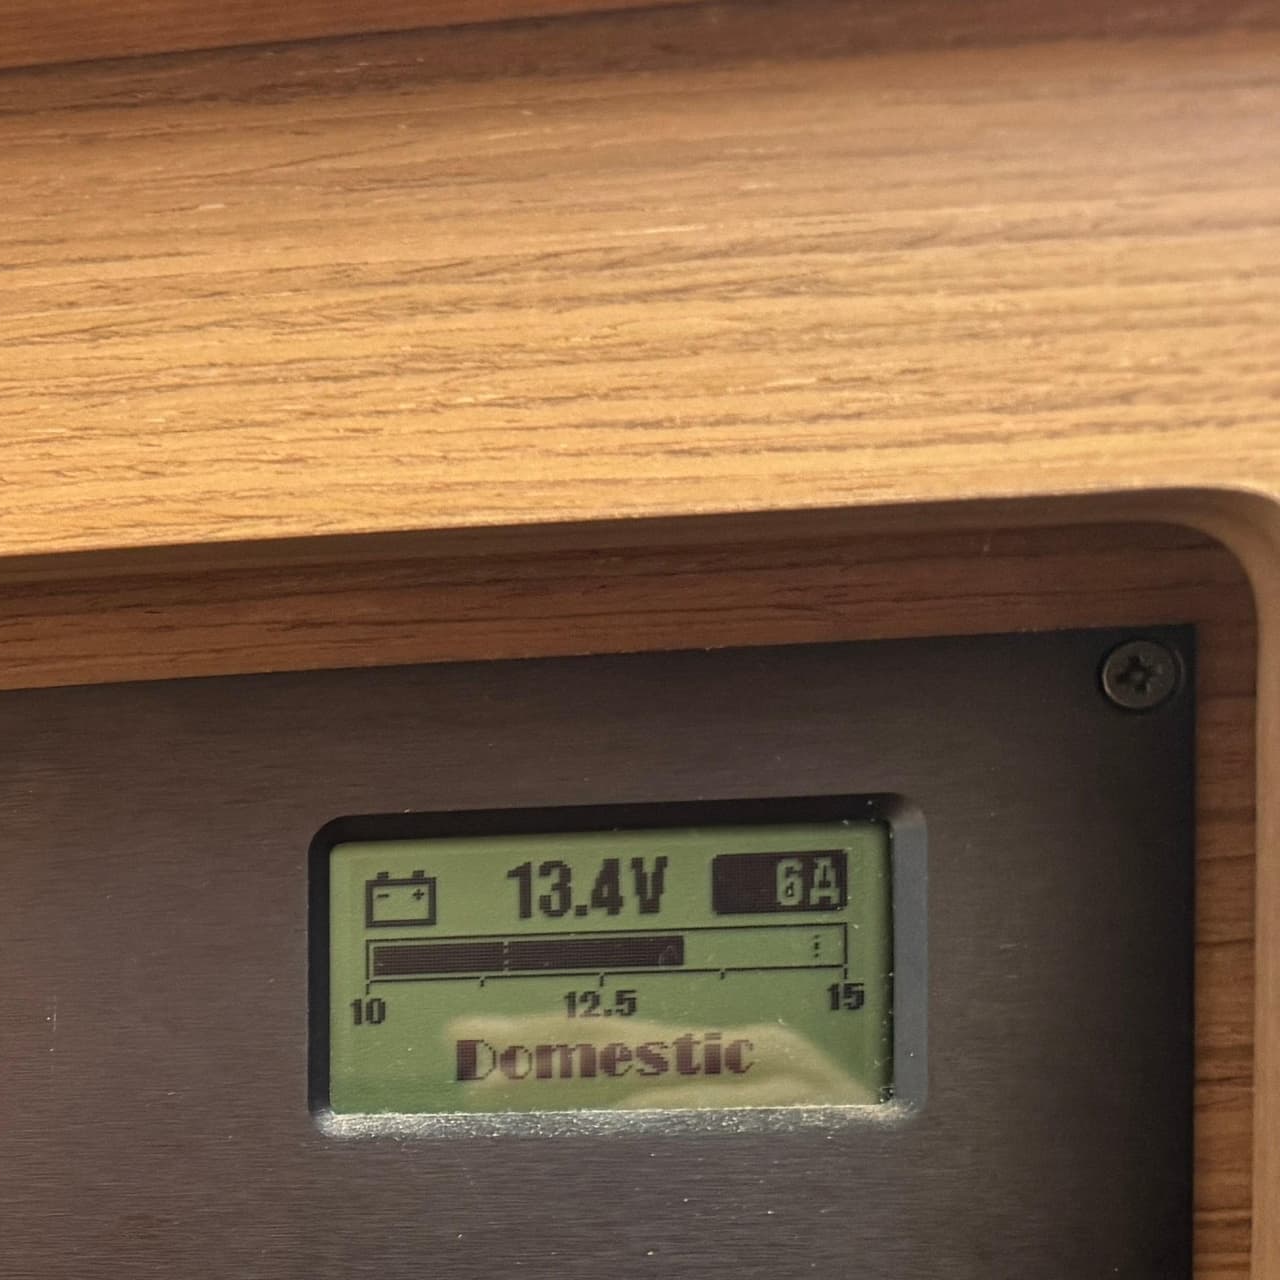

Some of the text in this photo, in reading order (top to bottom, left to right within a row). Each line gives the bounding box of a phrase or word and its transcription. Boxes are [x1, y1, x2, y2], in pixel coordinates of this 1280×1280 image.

[506, 855, 669, 920] 13.4V
[351, 997, 387, 1026] 10
[564, 989, 638, 1019] 12.5
[827, 982, 865, 1012] 15
[455, 1033, 756, 1082] Domestic
